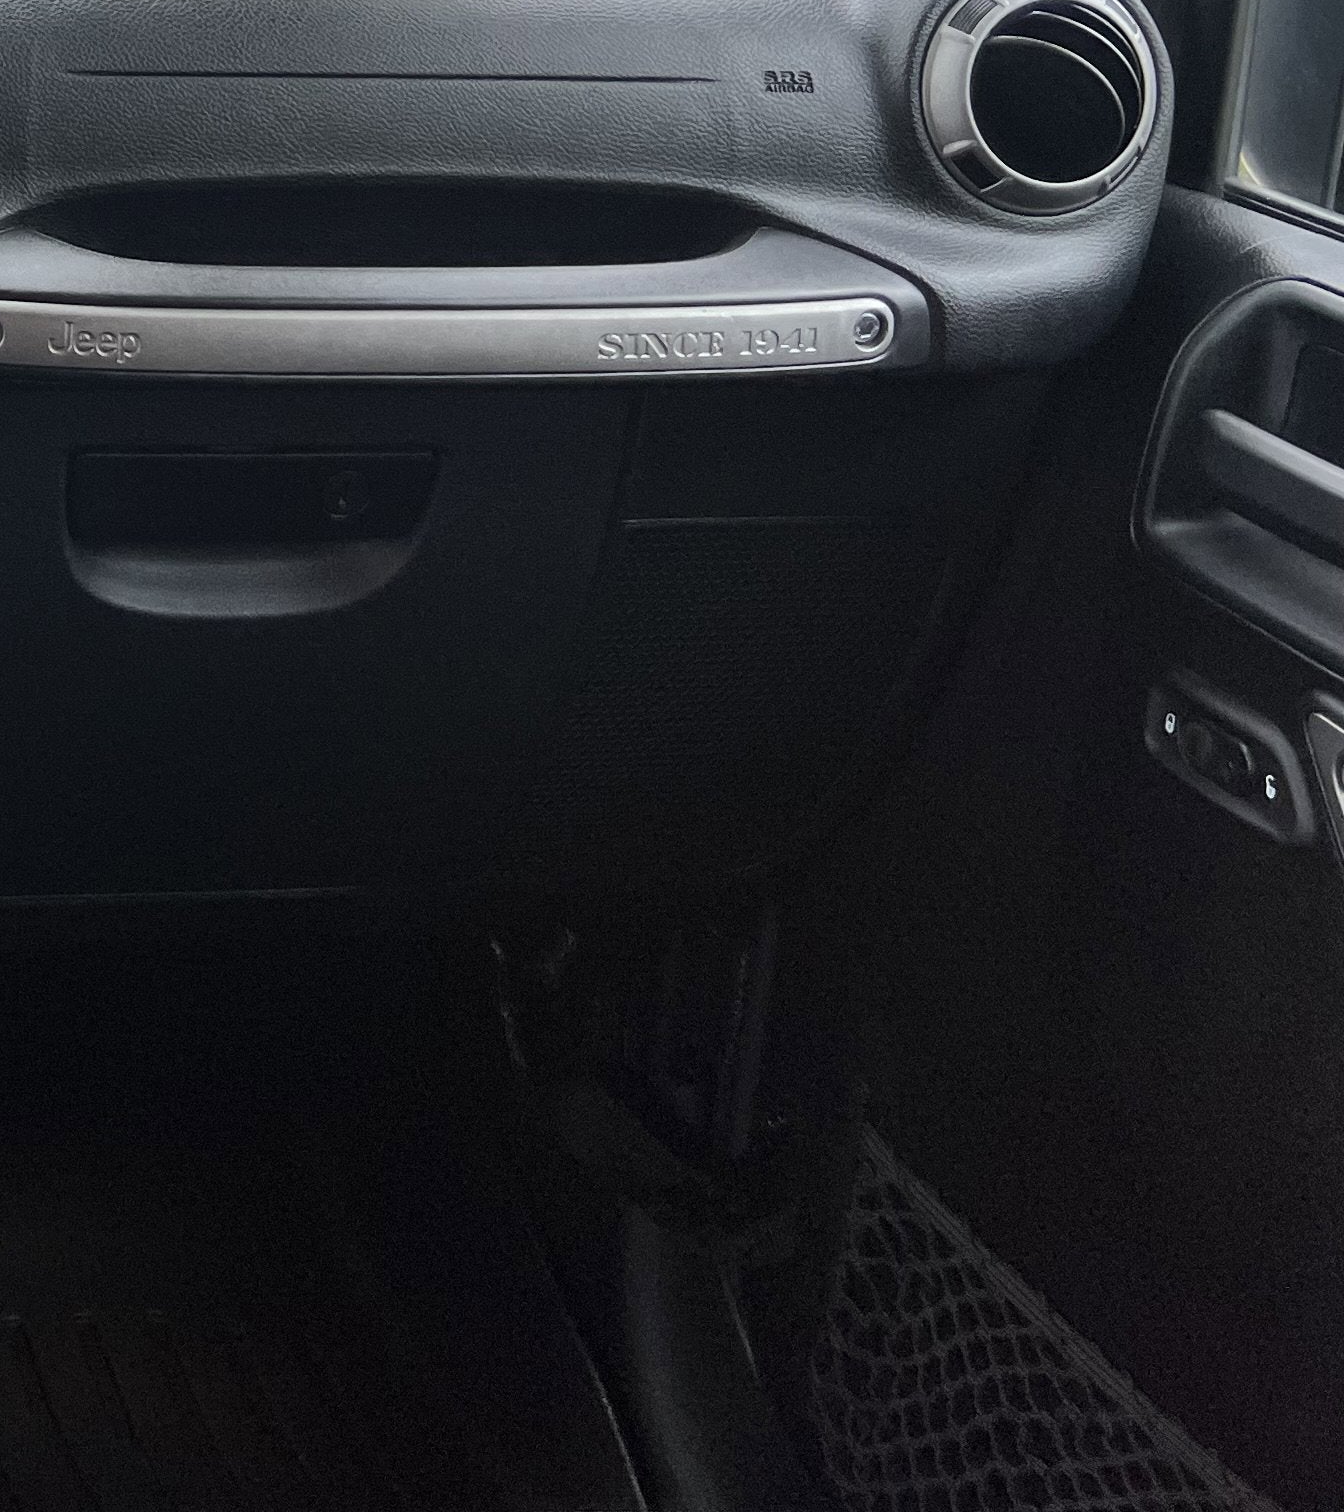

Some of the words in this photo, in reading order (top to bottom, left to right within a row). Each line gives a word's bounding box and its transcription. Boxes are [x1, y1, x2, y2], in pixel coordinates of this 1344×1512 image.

[764, 71, 812, 85] SRS
[48, 321, 142, 364] Jeep
[597, 330, 725, 360] SINCE
[739, 327, 818, 356] 1941
